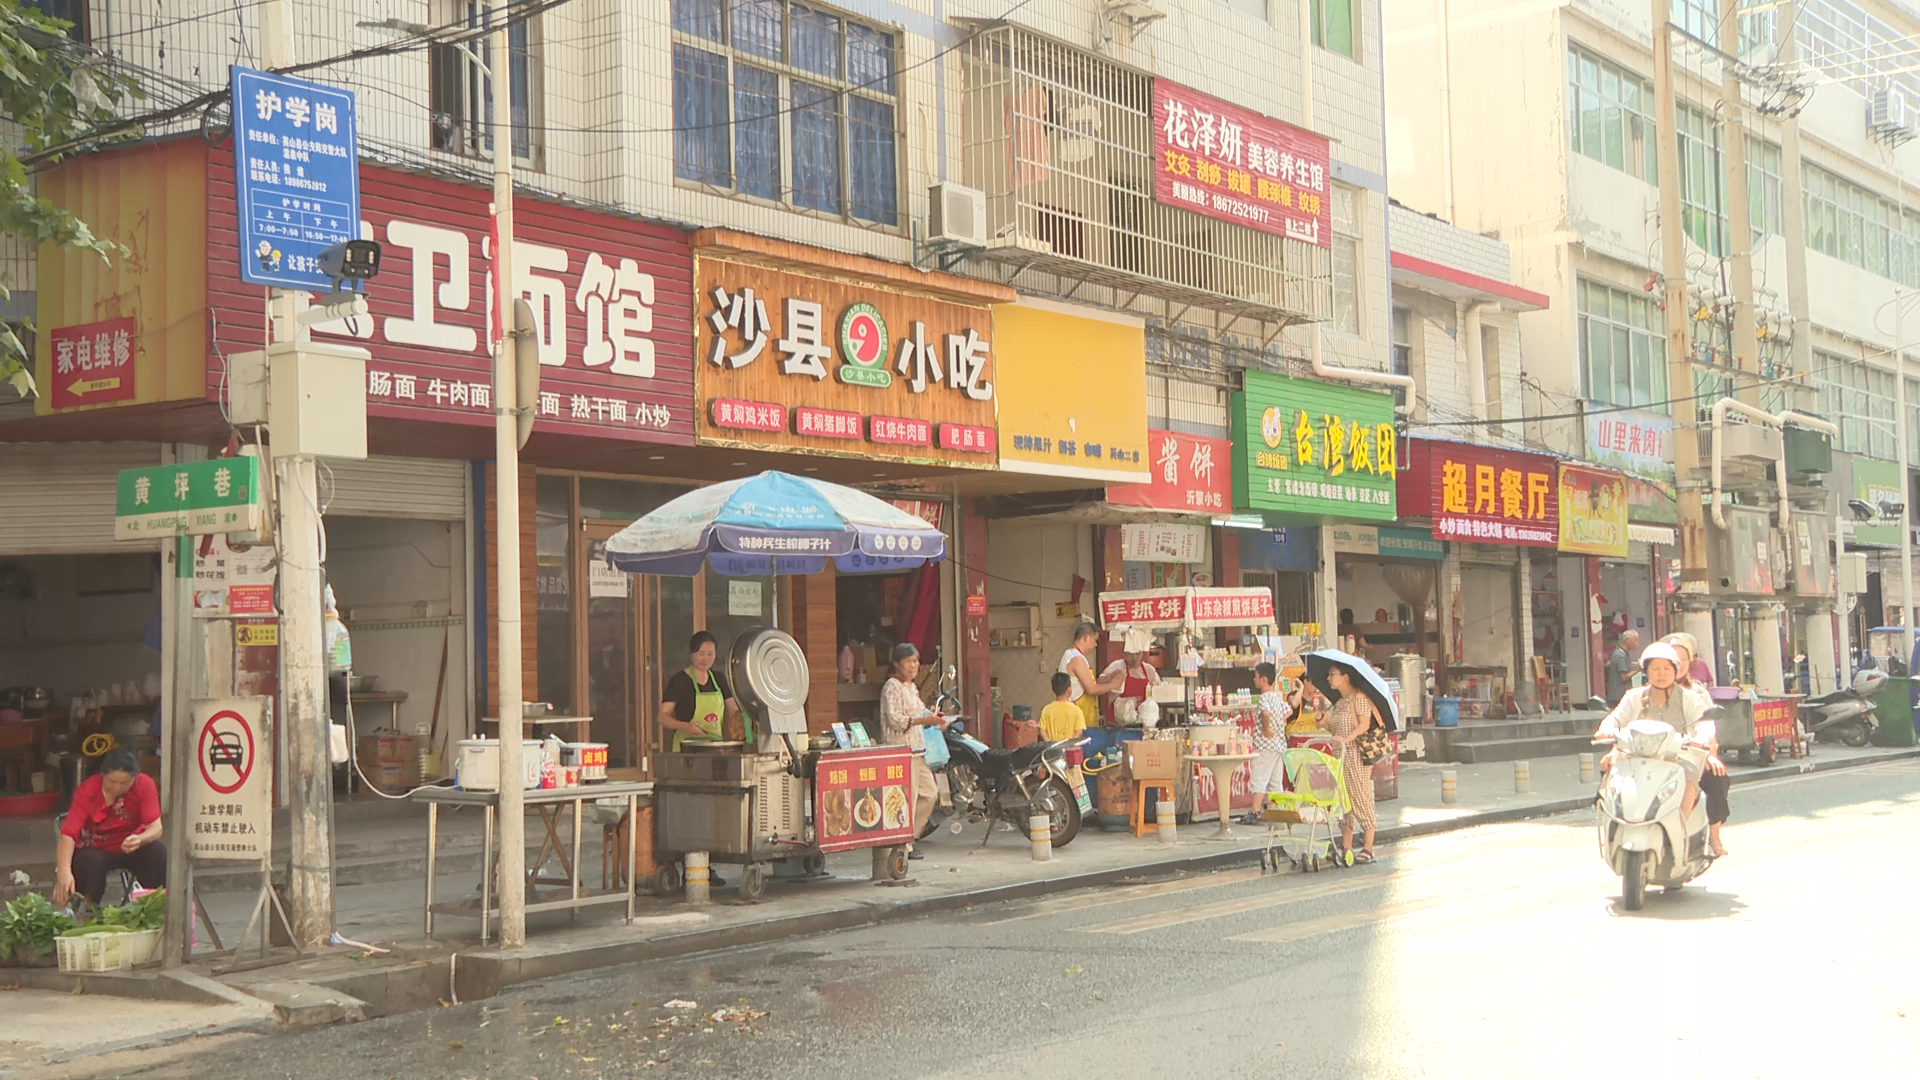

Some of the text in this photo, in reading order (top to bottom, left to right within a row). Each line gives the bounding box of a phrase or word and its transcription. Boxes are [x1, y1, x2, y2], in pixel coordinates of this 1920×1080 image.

[256, 89, 337, 134] 护学岗
[1163, 99, 1324, 192] 花泽妍 美容养生馆
[282, 197, 321, 212] 护学时间
[1164, 150, 1321, 216] 艾灸 刮痧 拔罐 腰颈椎 纹绣
[266, 209, 338, 229] 上午 下午
[57, 329, 130, 374] 家电维修
[706, 286, 993, 400] 沙县 小吃
[845, 369, 887, 384] 沙县小吃
[366, 371, 672, 428] 肠面 牛肉面 面 热干面 小炒
[720, 403, 985, 447] 黄焖鸡米饭 黄焖猪脚饭 红烧牛肉面 肥肠面
[1295, 410, 1396, 480] 台湾饭团
[134, 467, 231, 505] 黄坪巷
[1442, 460, 1549, 519] 超月餐厅
[147, 514, 216, 529] HUANGPING XIANG
[1106, 598, 1271, 621] 手抓饼 山东杂粮煎饼果子
[195, 822, 256, 834] 机动车禁止驶入
[200, 804, 243, 816] 上放学期间
